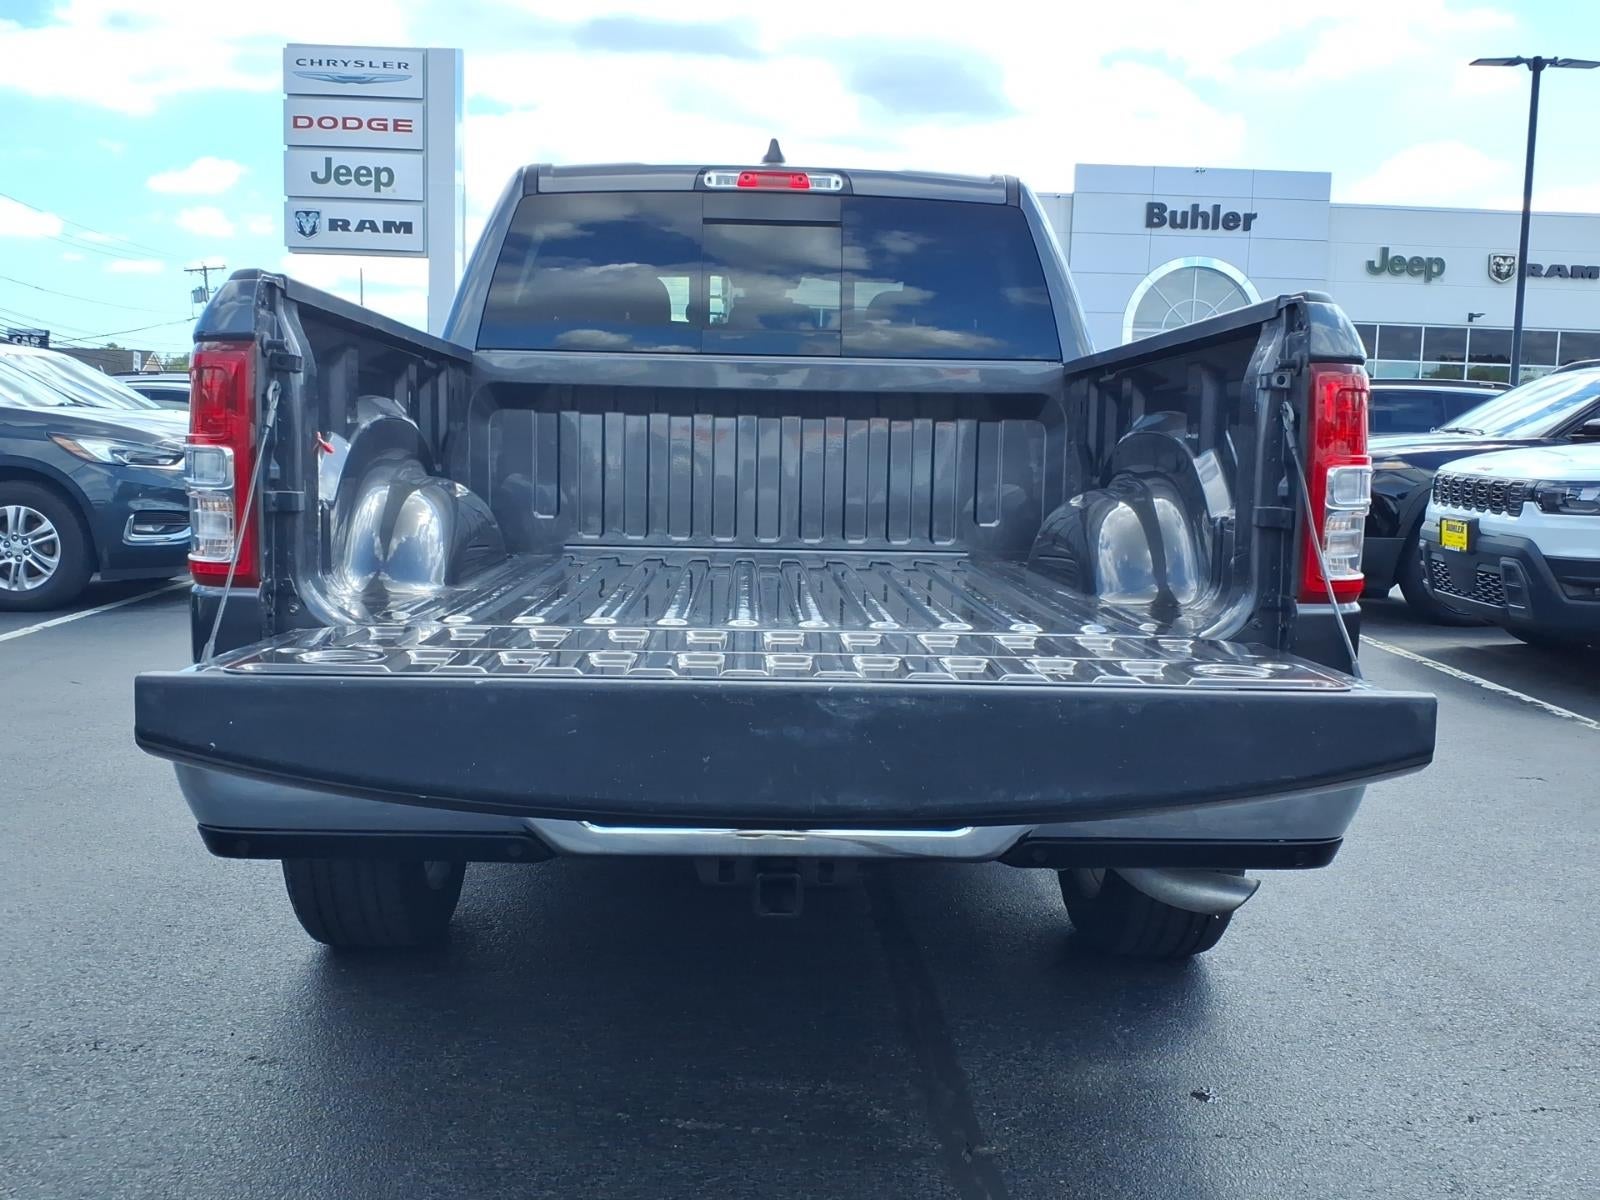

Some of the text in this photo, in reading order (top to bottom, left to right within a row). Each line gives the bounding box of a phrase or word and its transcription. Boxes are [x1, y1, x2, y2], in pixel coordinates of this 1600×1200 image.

[295, 58, 410, 69] CHRYSLER
[292, 115, 414, 133] DODGE
[310, 156, 396, 193] Jeep
[1145, 201, 1258, 232] Buhler
[328, 217, 414, 235] RAM
[1366, 246, 1446, 283] Jeep
[1526, 263, 1600, 279] RAM
